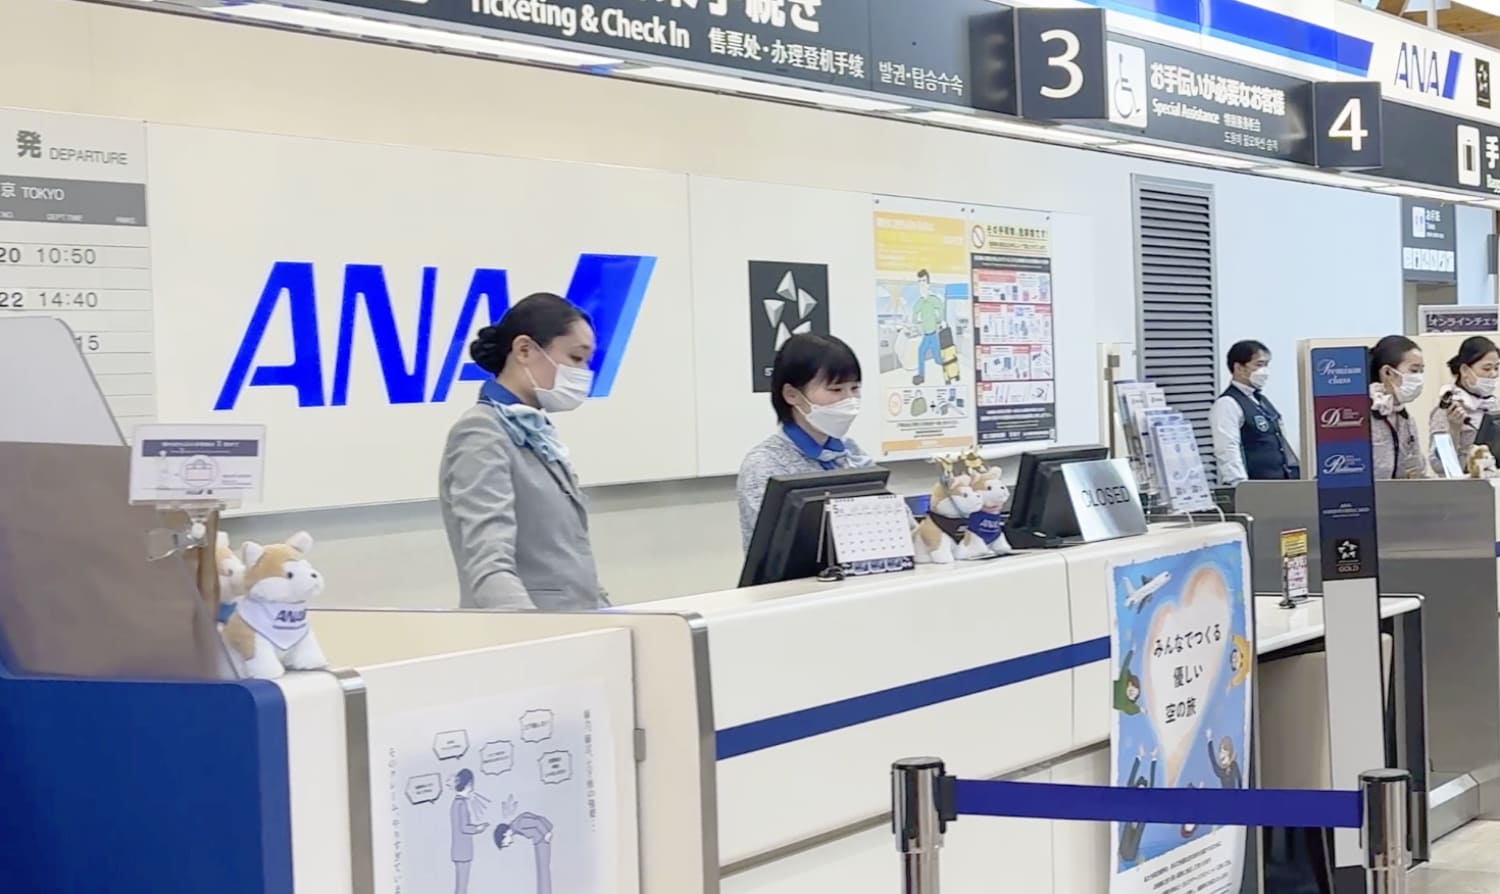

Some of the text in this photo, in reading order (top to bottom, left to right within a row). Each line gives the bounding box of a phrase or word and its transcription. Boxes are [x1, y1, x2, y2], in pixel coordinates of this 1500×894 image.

[580, 5, 599, 32] &
[602, 8, 667, 45] Check
[669, 20, 690, 48] In
[1040, 29, 1084, 99] 3
[1394, 42, 1440, 97] ANA
[1150, 62, 1286, 116] お手伝いが必要なお客様
[1152, 98, 1220, 125] Special Assistance
[1328, 98, 1369, 151] 4
[17, 130, 42, 159] 発
[49, 147, 128, 165] DEPARTURE
[21, 186, 65, 201] TOKYO
[37, 248, 97, 264] 10:50
[0, 292, 99, 308] 22 14:40
[1317, 358, 1362, 376] Premium
[1080, 484, 1132, 509] CLOSED
[1153, 623, 1222, 658] みんなでつくる
[1173, 664, 1204, 689] 優しい
[1165, 697, 1198, 724] 空の旅
